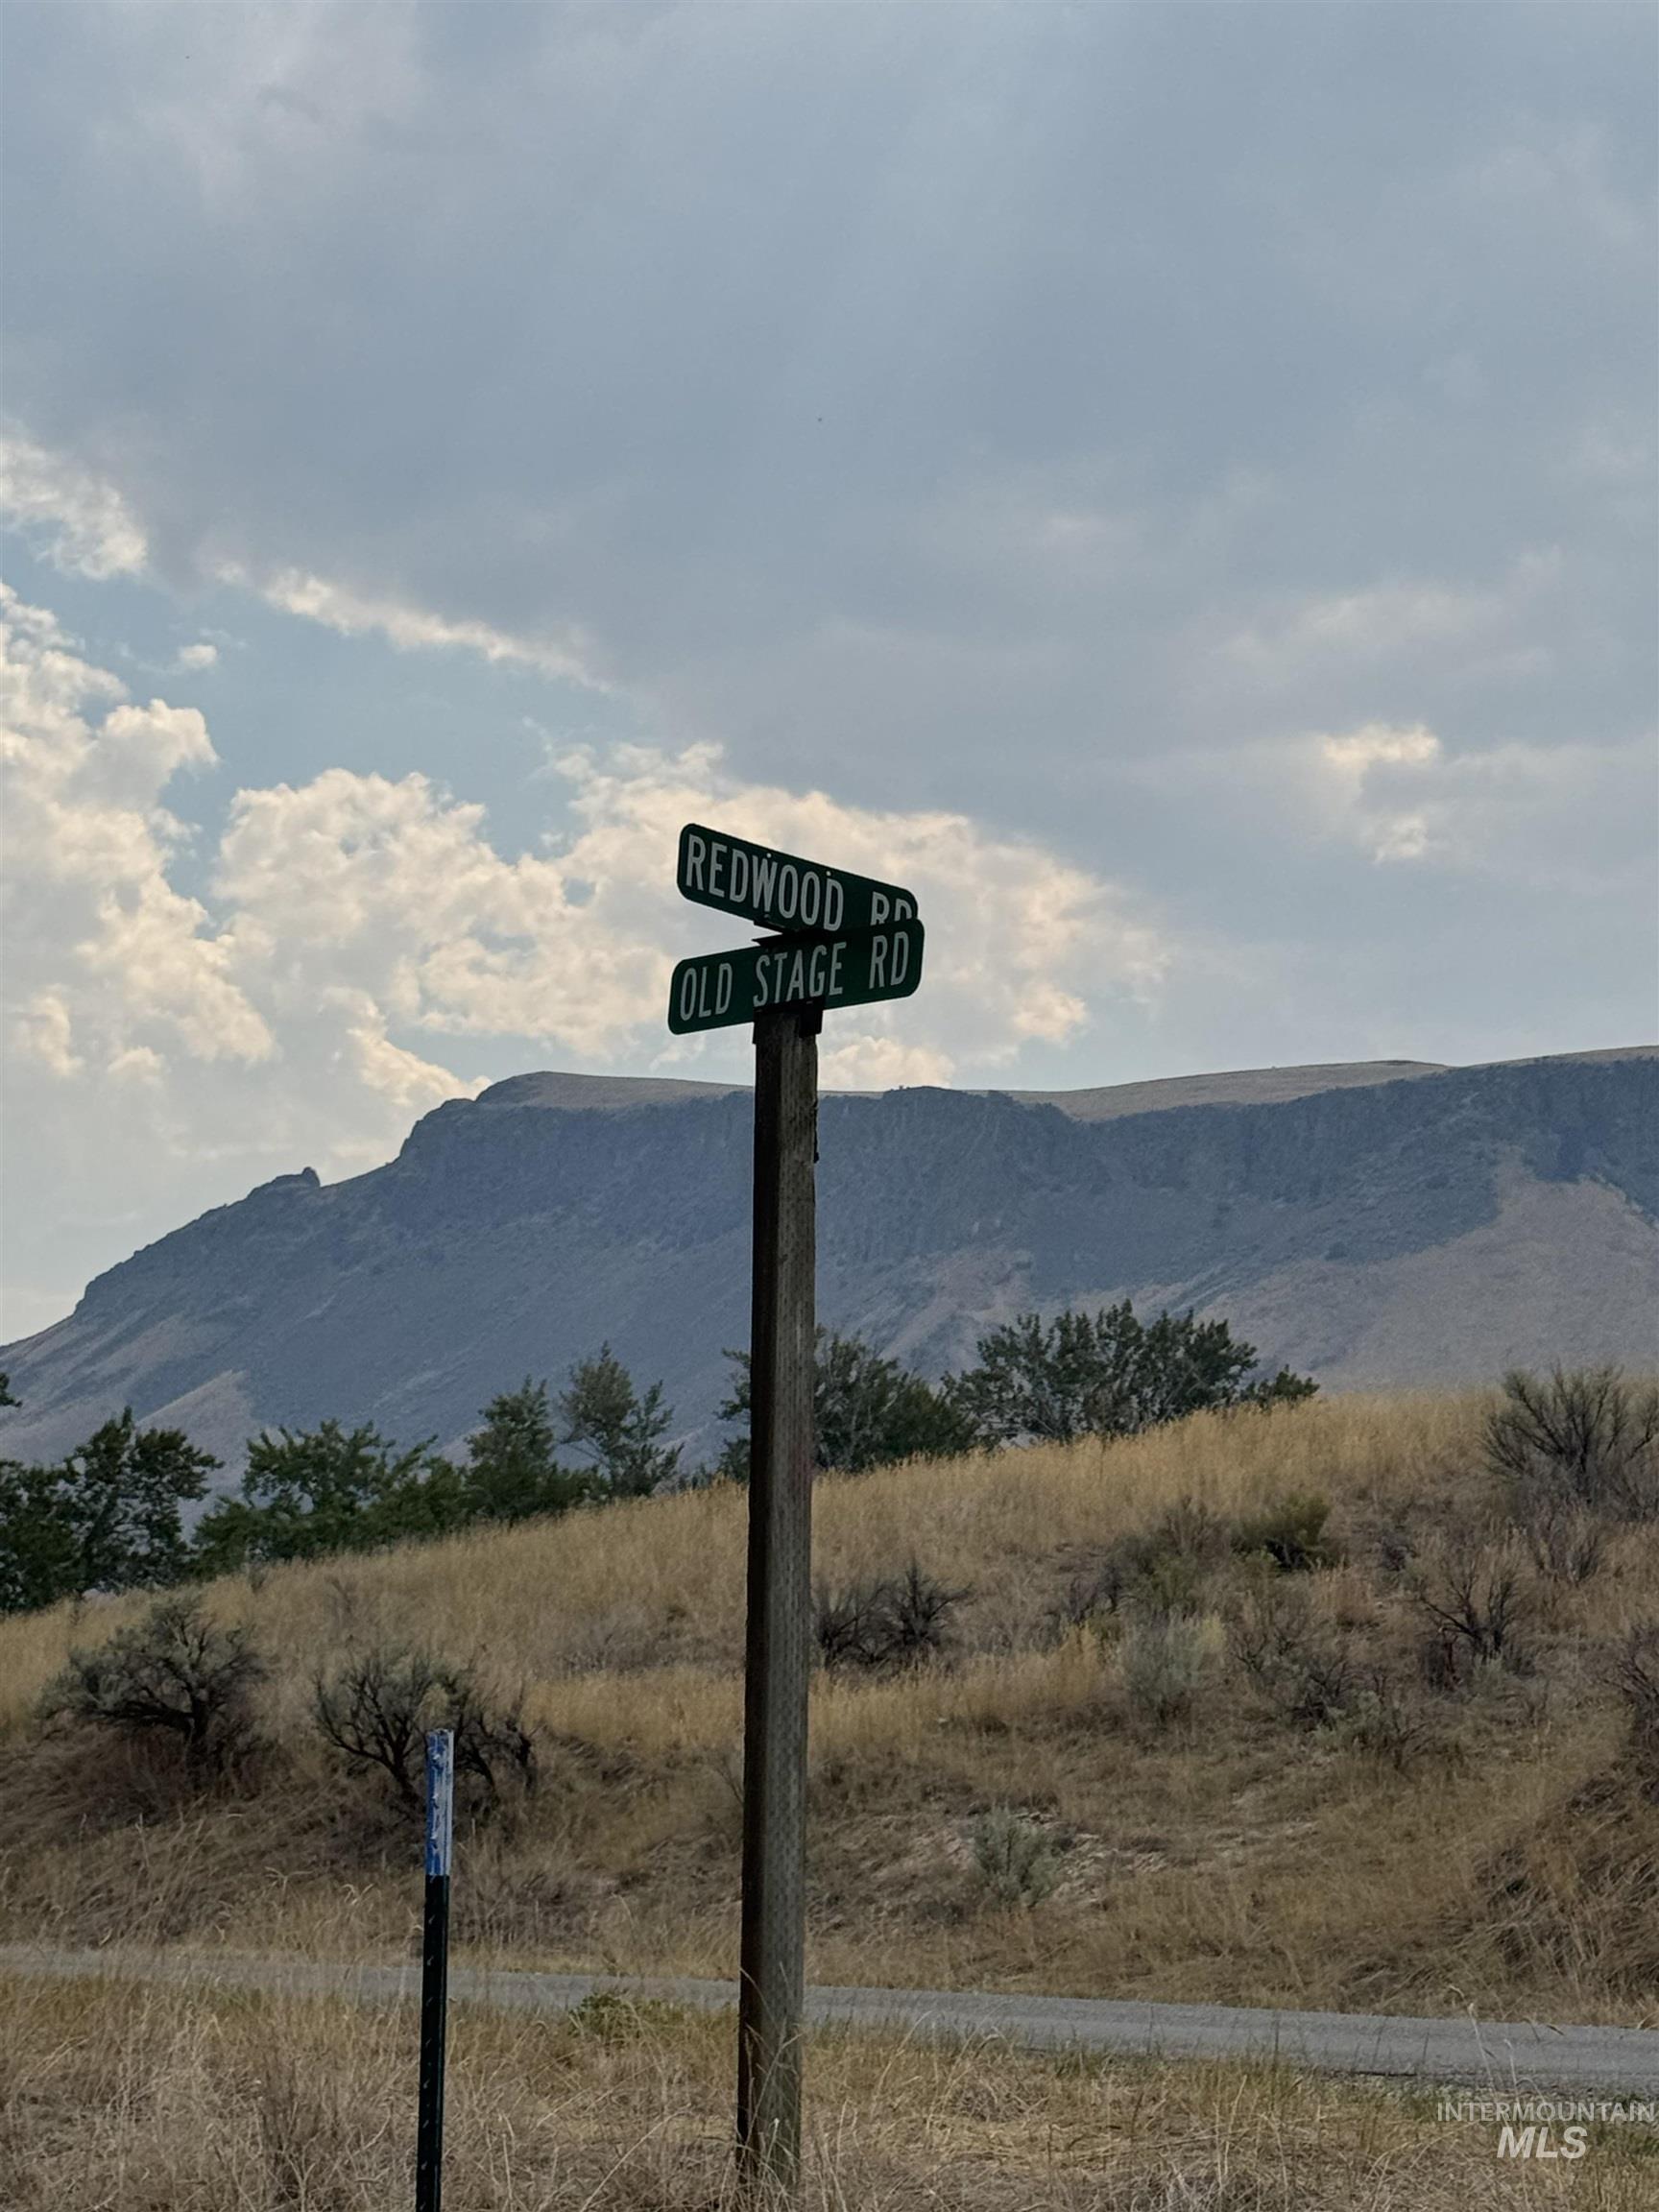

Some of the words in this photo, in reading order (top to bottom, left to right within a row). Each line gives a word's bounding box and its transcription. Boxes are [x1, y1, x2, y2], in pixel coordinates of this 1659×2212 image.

[685, 833, 844, 931] REDWOOD
[680, 963, 733, 1022] OLD
[753, 942, 847, 1007] STAGE
[869, 931, 909, 989] RD
